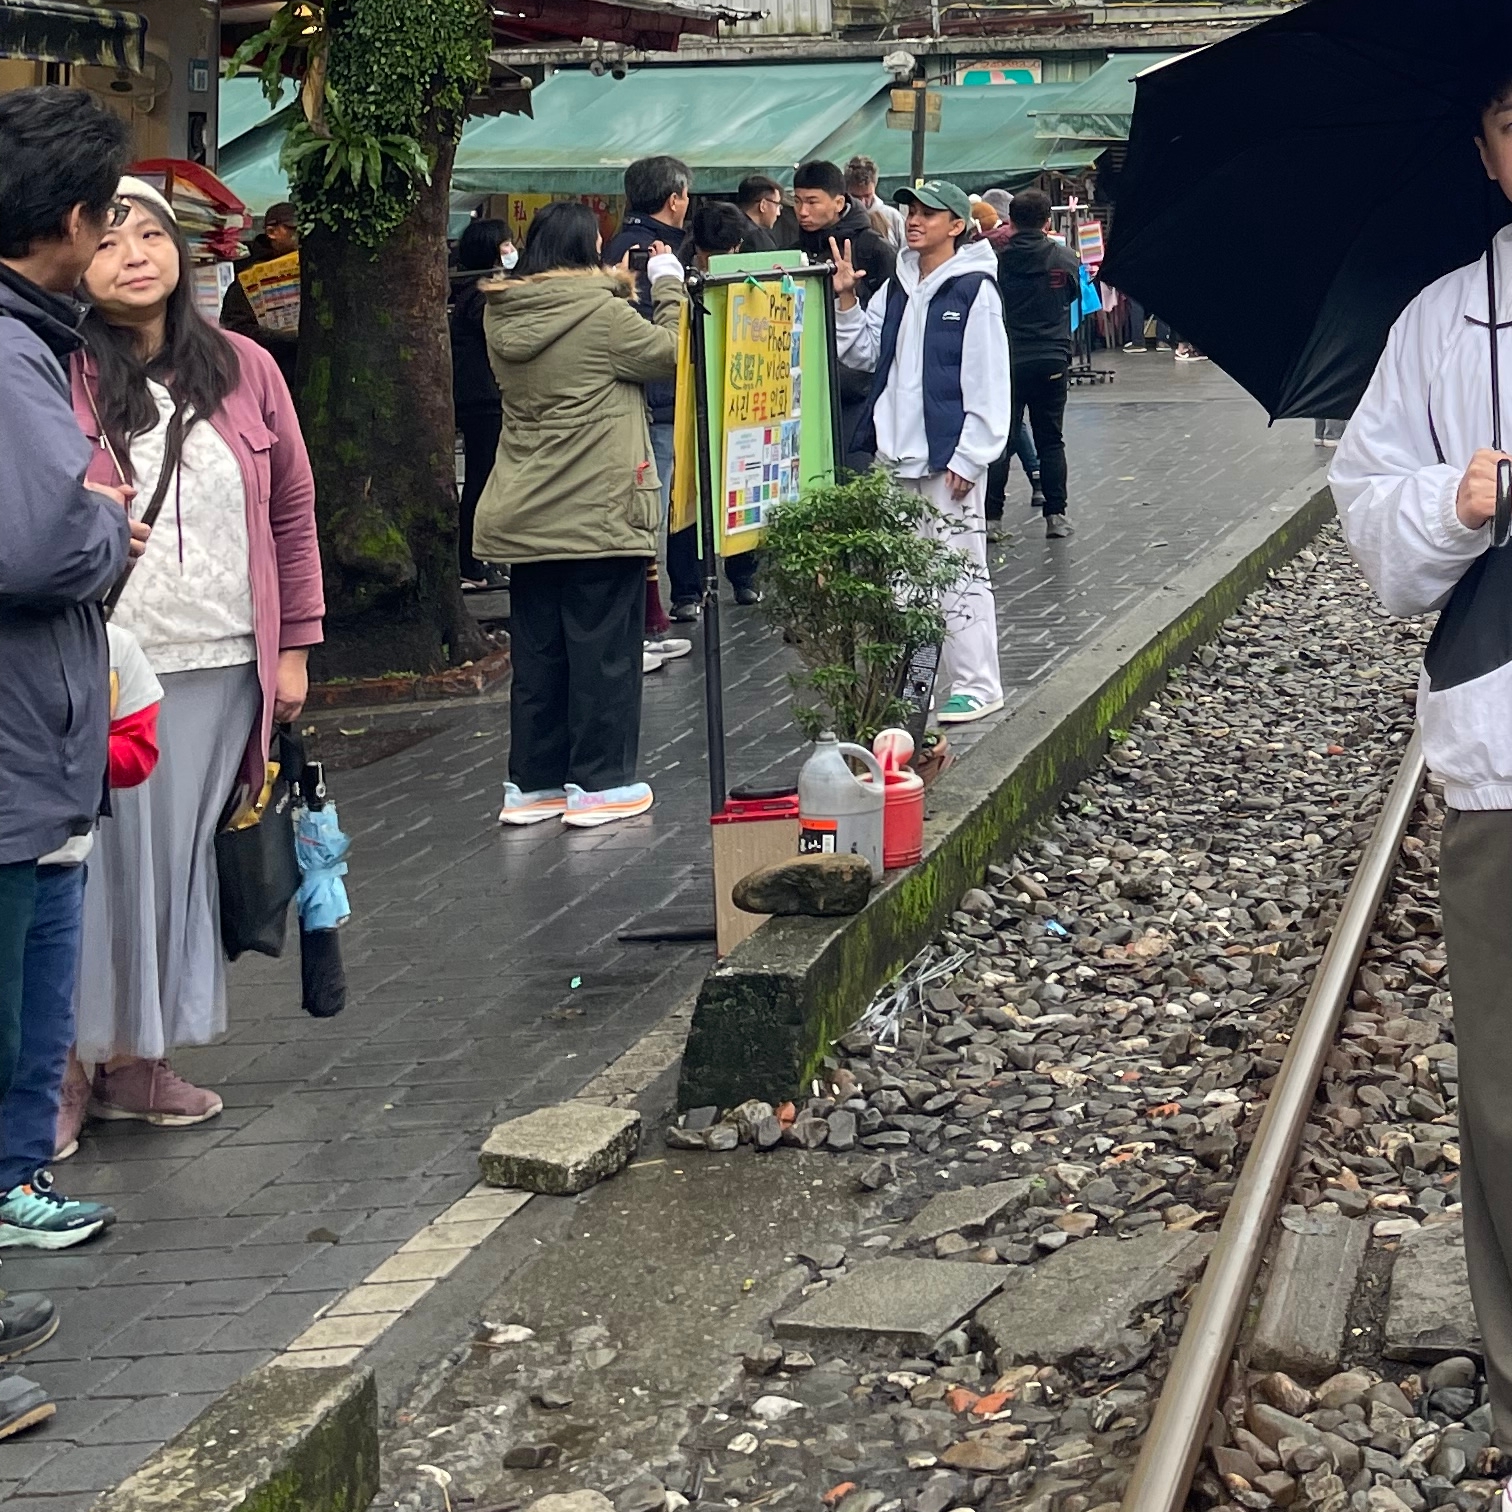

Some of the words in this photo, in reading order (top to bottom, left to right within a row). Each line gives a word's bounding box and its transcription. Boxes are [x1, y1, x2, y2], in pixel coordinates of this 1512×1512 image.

[732, 294, 768, 342] Free
[728, 391, 750, 421] 사진
[752, 392, 768, 421] 무료
